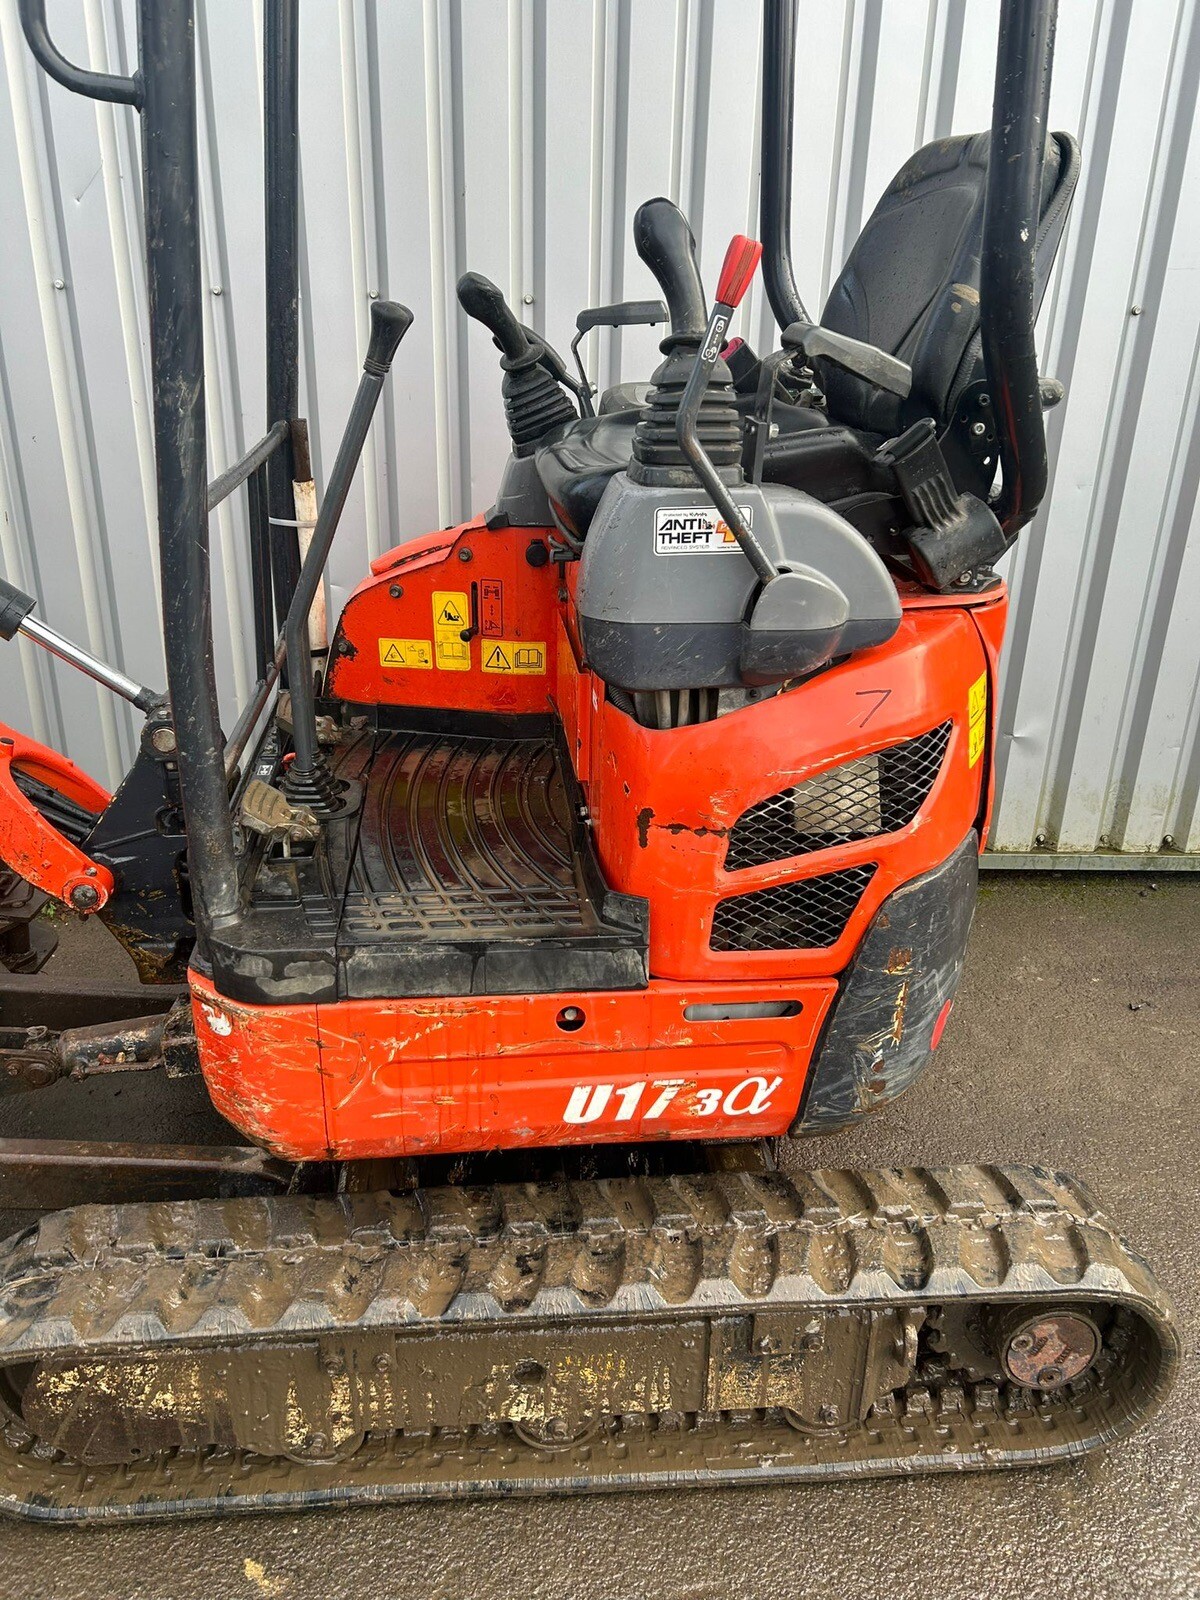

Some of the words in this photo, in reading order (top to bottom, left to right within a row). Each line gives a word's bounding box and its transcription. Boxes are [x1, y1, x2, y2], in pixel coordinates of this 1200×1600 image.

[659, 519, 702, 531] ANTI
[658, 532, 713, 544] THEFT
[562, 1079, 686, 1124] U17
